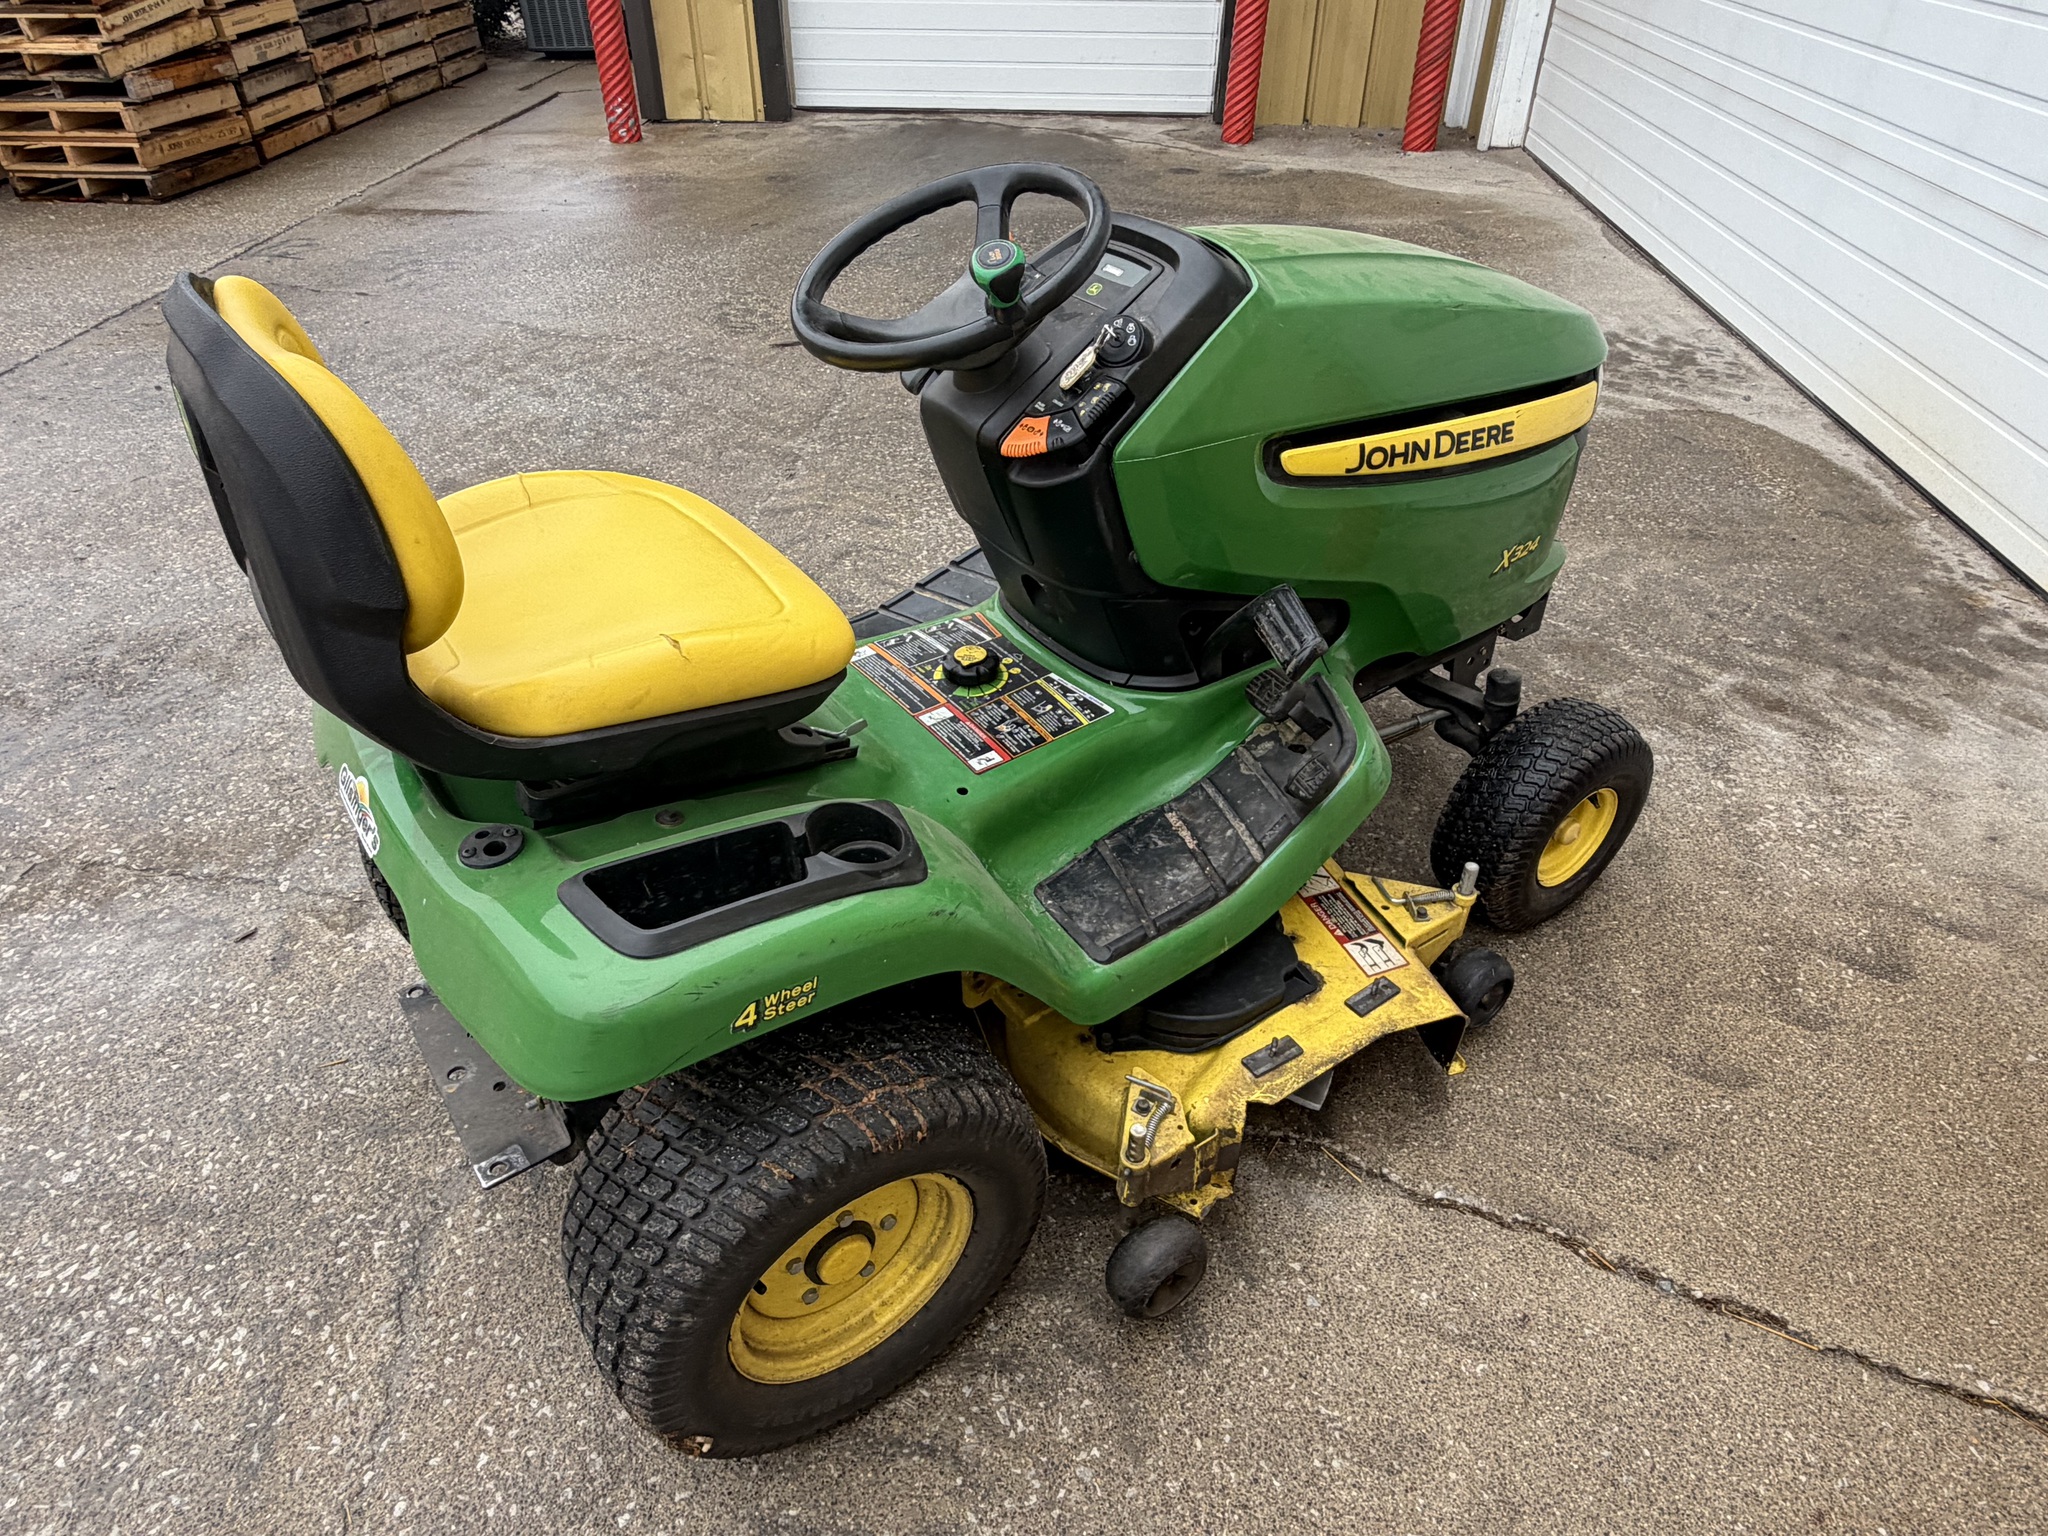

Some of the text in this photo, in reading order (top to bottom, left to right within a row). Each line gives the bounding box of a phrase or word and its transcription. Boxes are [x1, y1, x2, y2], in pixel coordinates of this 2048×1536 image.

[1345, 421, 1515, 474] JOHN DEERE
[1491, 535, 1541, 576] X324
[1309, 902, 1338, 933] DANGER
[734, 976, 818, 1028] 4 Wheel
[763, 992, 816, 1021] Steer
